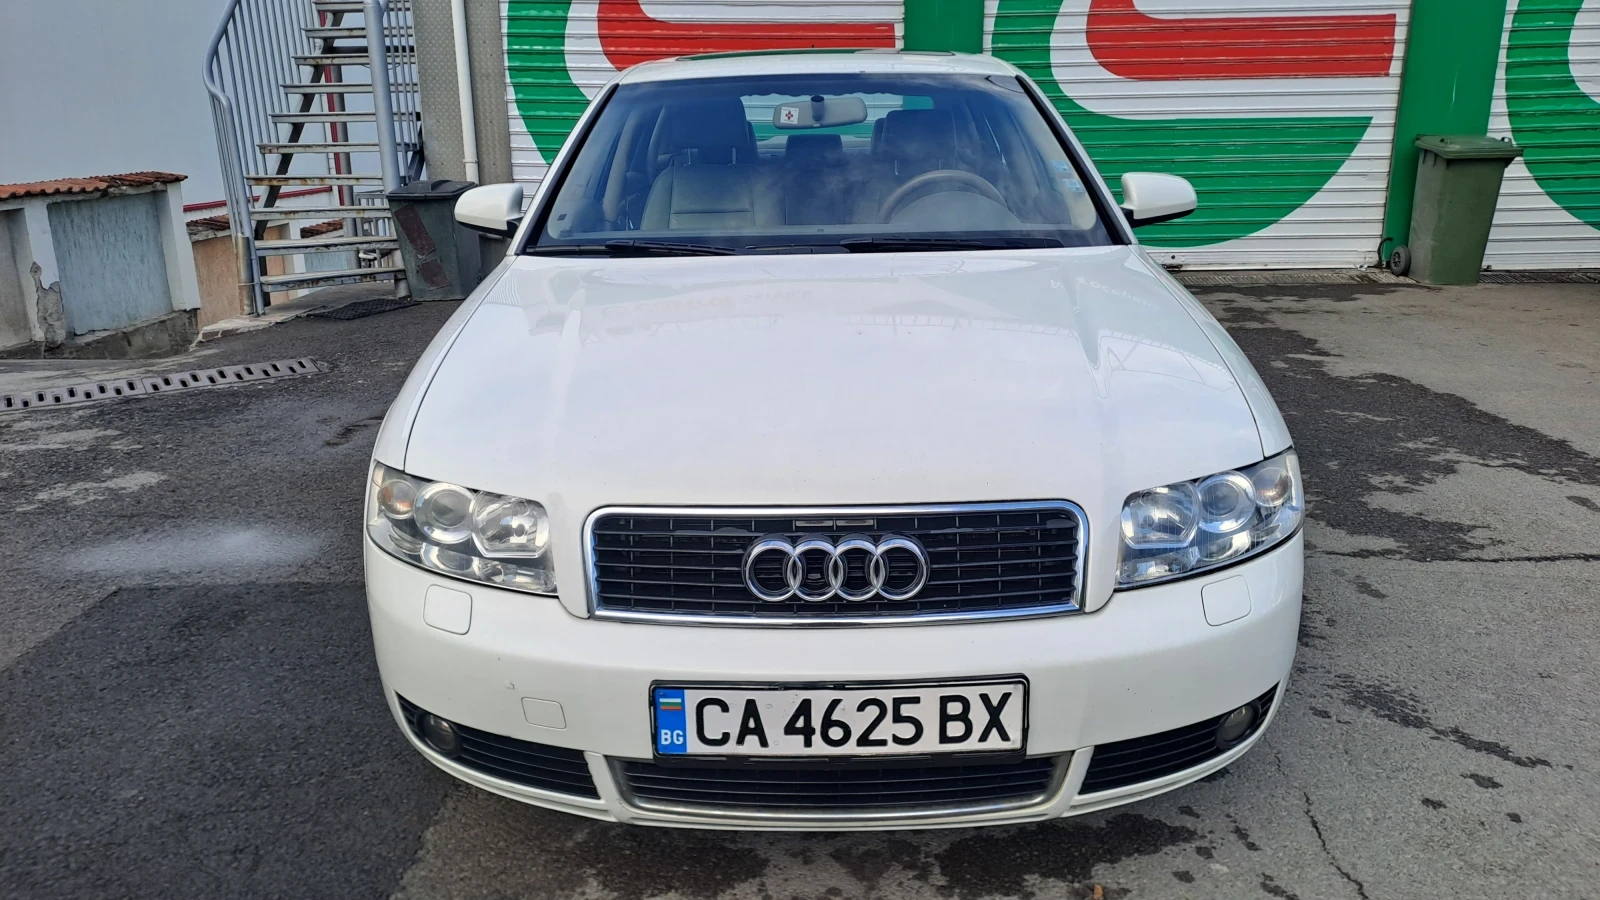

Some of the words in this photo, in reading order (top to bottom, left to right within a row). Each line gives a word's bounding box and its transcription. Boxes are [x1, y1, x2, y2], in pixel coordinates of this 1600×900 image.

[660, 729, 684, 745] BG
[695, 697, 769, 748] CA
[783, 696, 924, 748] 4625
[939, 692, 1012, 744] BX
